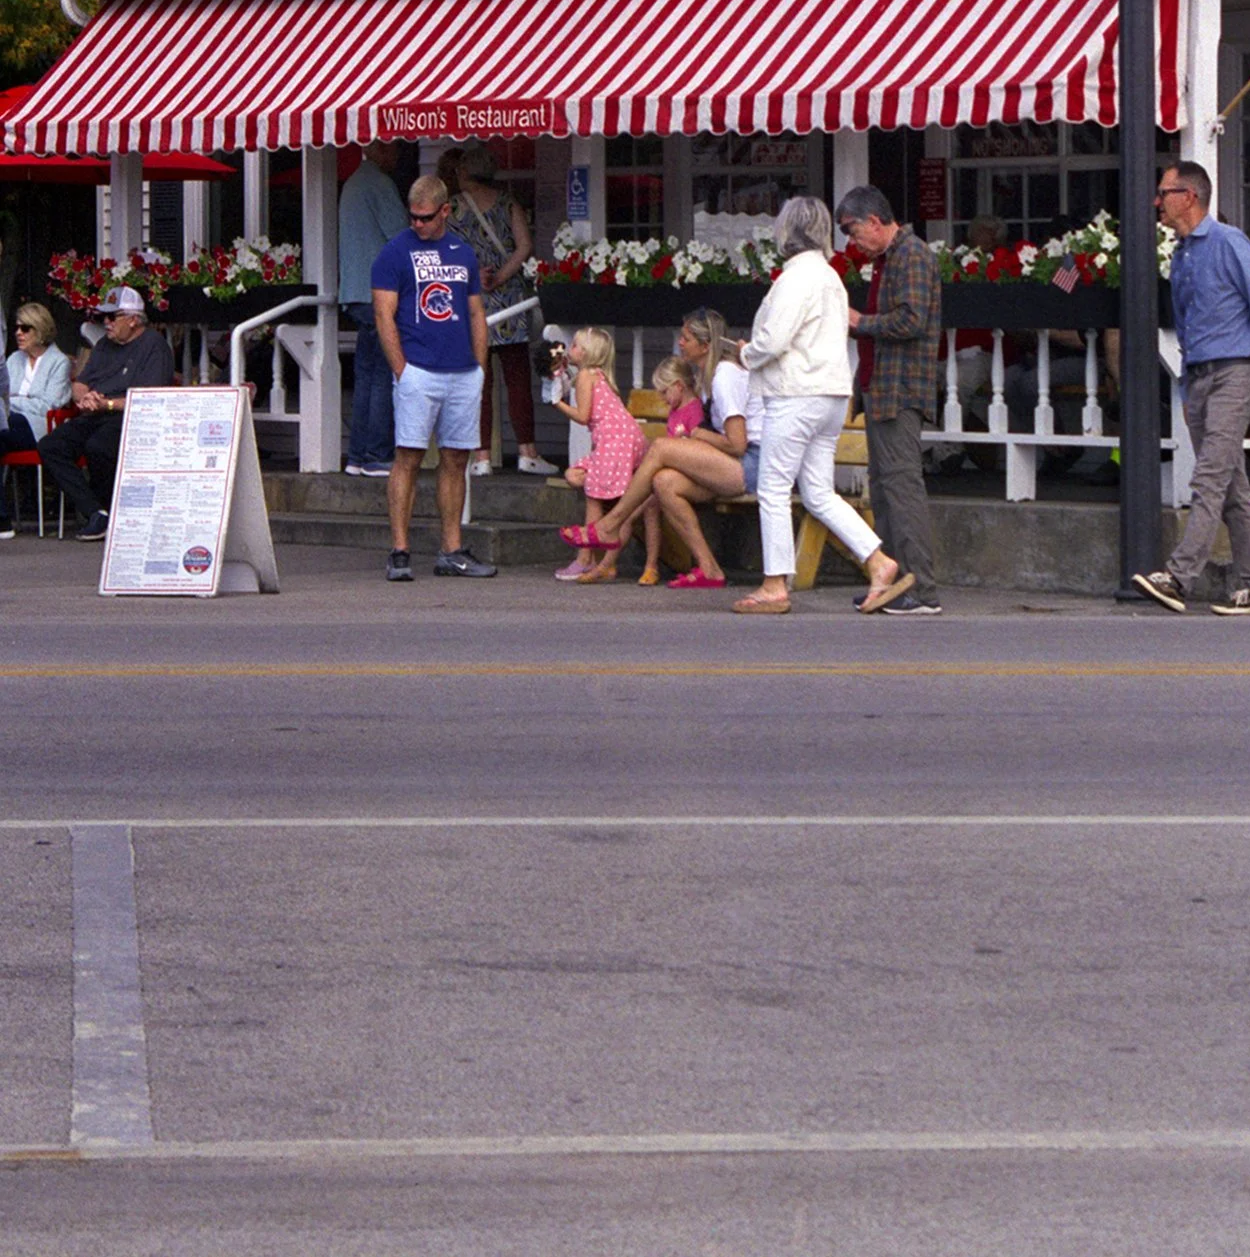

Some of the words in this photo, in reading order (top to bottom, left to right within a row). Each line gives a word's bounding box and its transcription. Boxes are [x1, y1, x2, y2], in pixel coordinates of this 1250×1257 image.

[382, 107, 447, 131] Wilson's
[456, 104, 546, 129] Restaurant
[417, 267, 468, 280] CHAMPS
